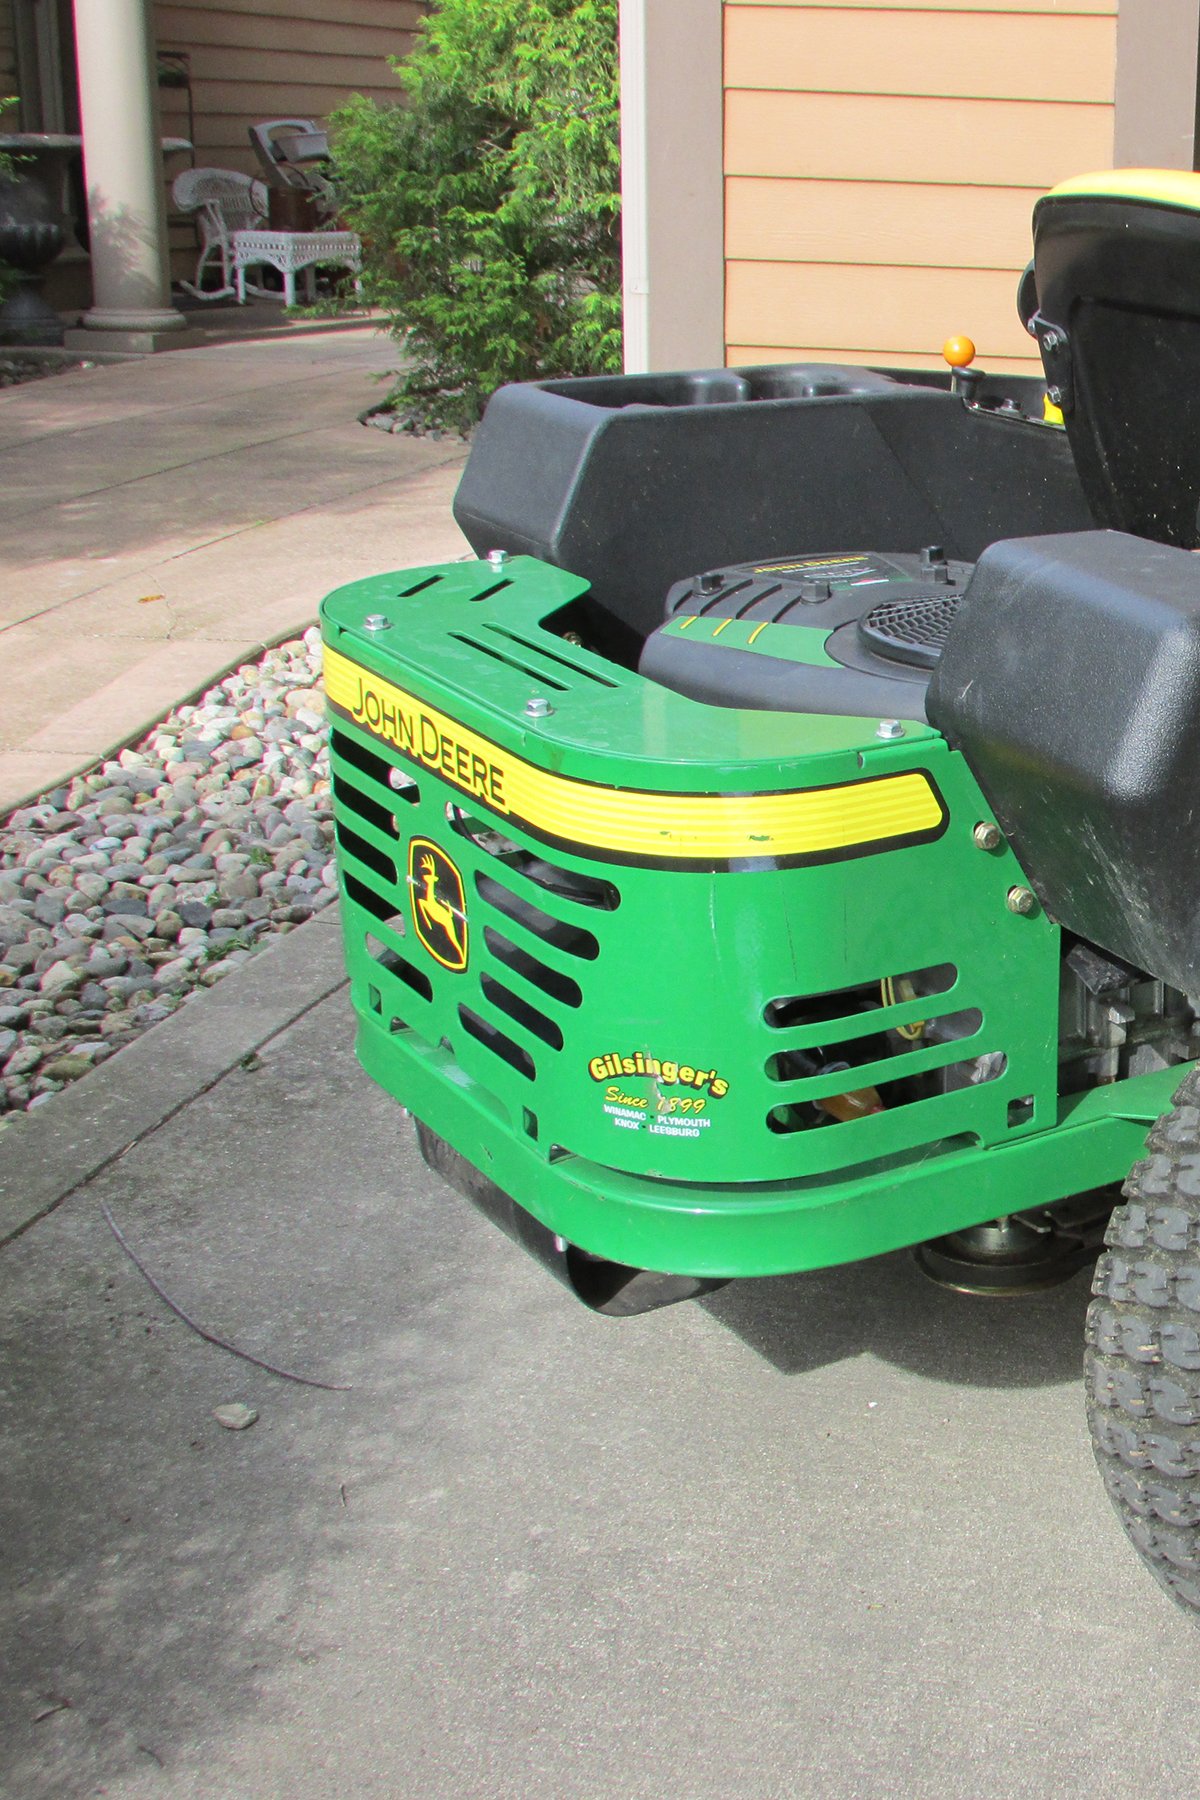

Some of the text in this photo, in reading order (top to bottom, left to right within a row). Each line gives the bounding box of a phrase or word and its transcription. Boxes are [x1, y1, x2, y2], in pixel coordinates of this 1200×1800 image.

[353, 677, 507, 806] JOHN DEERE
[589, 1052, 729, 1099] Gilsinger's
[605, 1086, 706, 1114] Since 1899
[603, 1103, 711, 1128] WINAMAC PLYMOUTH
[614, 1117, 640, 1130] KNOX
